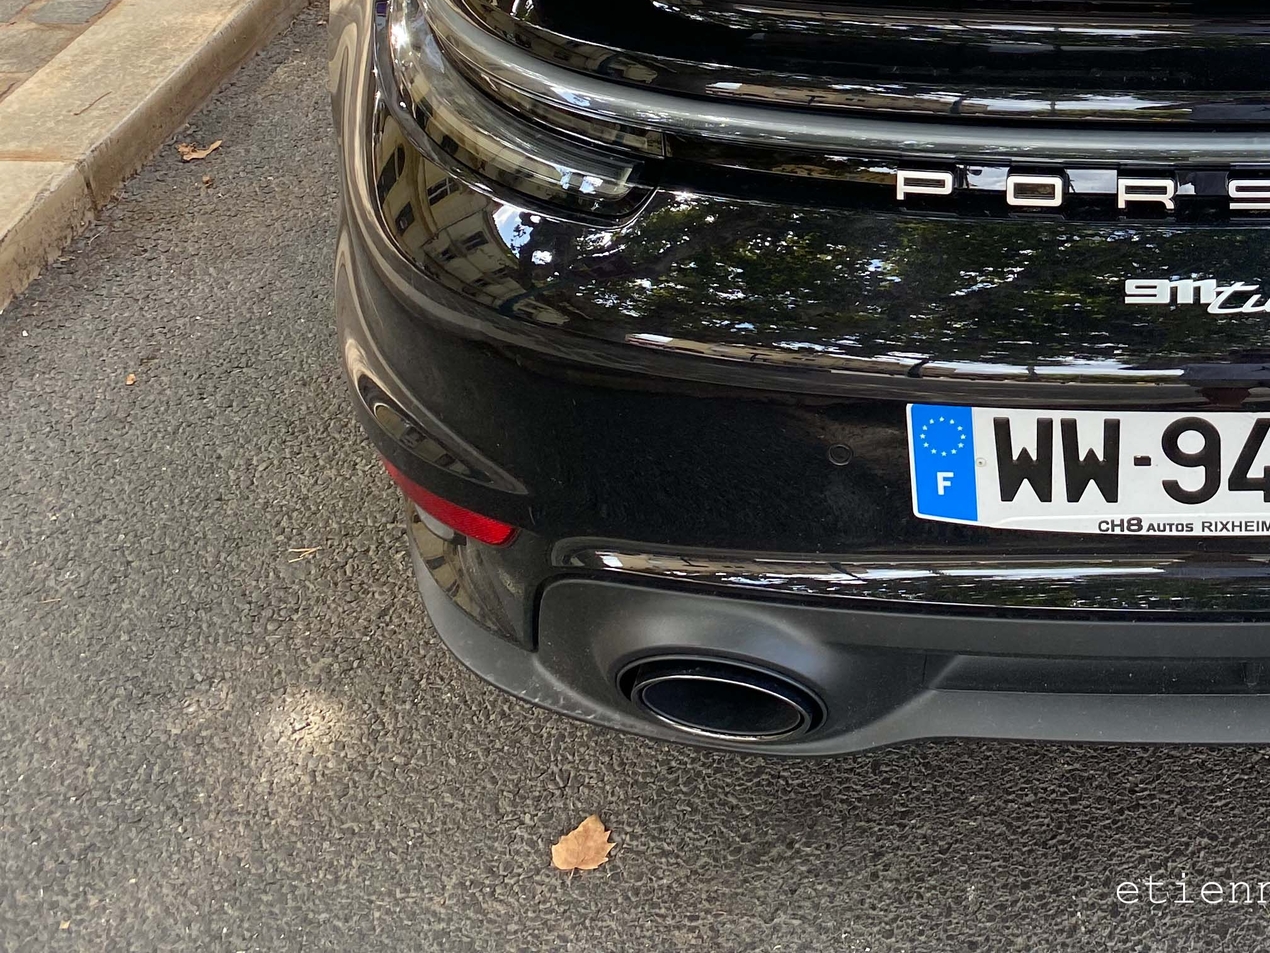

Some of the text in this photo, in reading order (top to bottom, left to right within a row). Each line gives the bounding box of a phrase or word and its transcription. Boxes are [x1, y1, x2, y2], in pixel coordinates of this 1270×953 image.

[1124, 279, 1217, 304] 911
[936, 472, 954, 496] F
[1098, 516, 1143, 532] CH8
[1146, 522, 1194, 532] AUTOS
